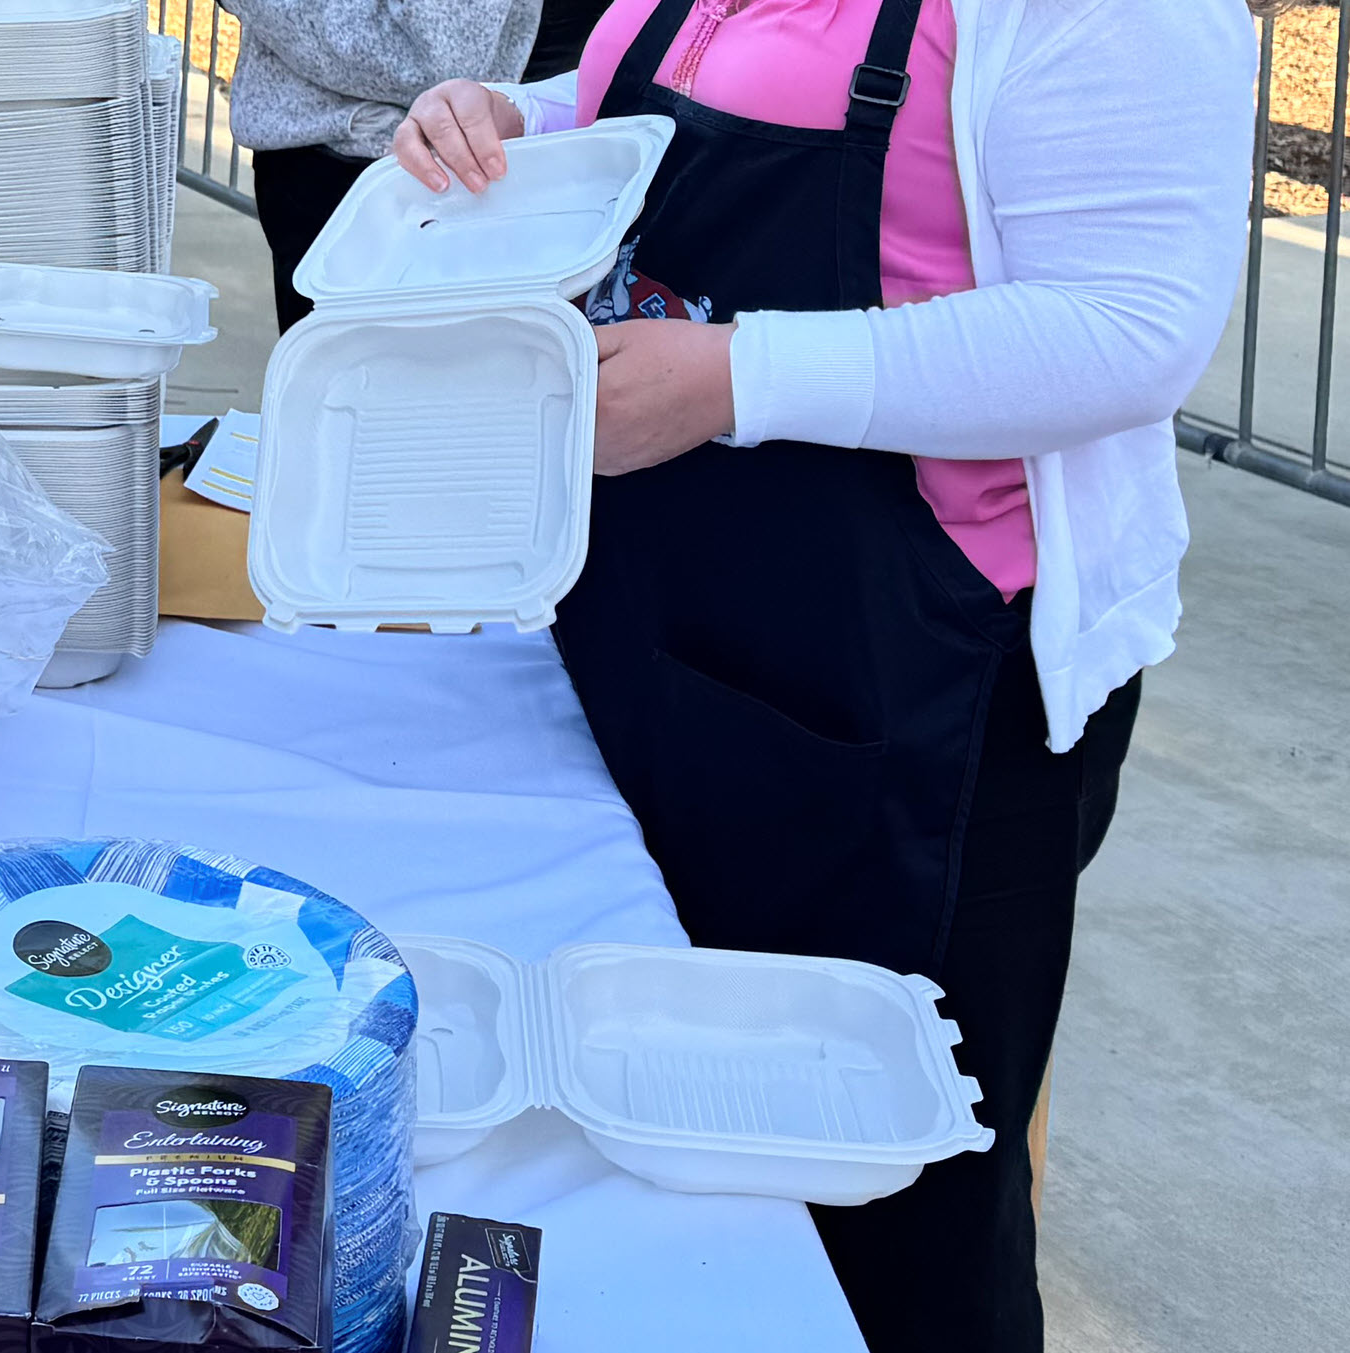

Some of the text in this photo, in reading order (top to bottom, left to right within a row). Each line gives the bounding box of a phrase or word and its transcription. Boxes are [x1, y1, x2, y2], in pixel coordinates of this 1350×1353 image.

[28, 933, 91, 971] Signature
[68, 941, 98, 961] SELECT
[65, 945, 184, 1010] Designer
[143, 973, 197, 1008] Coated
[162, 1020, 194, 1036] 150
[156, 1100, 247, 1118] Signature
[124, 1131, 267, 1154] Entertaining
[130, 1166, 257, 1178] Plastic Forks
[146, 1176, 238, 1187] & Spoons
[135, 1186, 246, 1196] Full Size Flatware
[127, 1264, 155, 1276] 72
